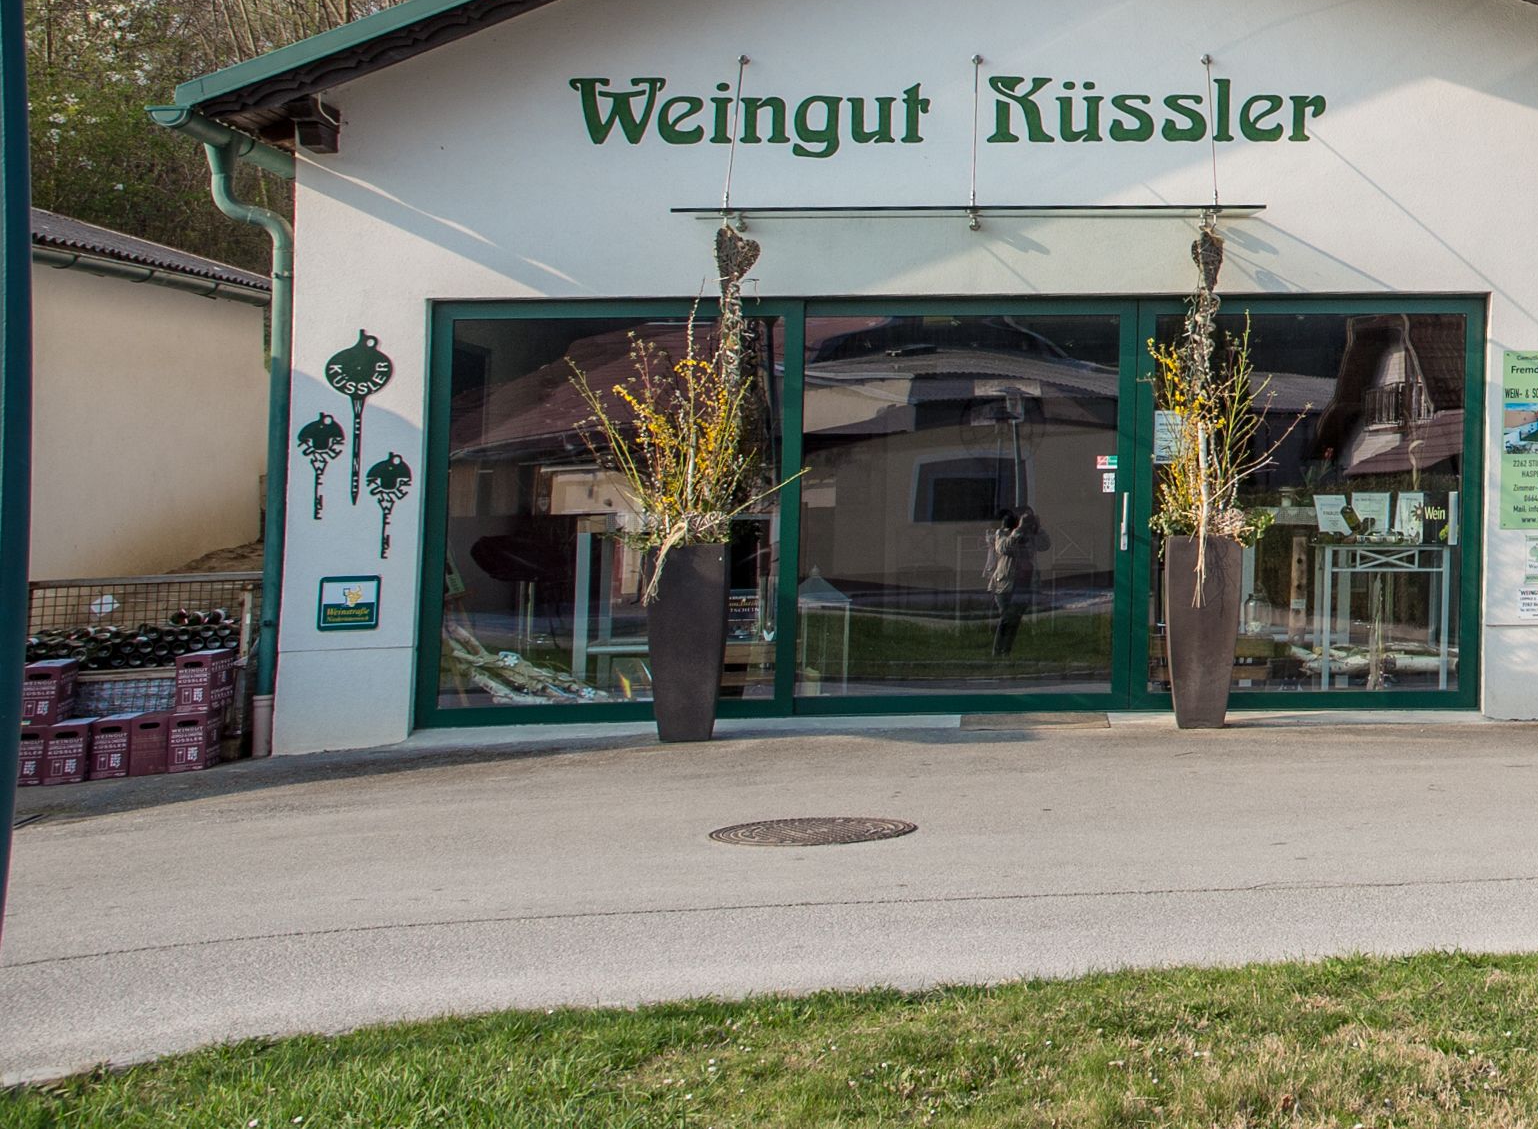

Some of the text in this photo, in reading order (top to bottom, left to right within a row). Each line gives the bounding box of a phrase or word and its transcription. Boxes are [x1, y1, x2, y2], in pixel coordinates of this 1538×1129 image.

[569, 75, 1327, 158] Weingut Küssler
[328, 361, 389, 395] KÜSSLER
[1504, 387, 1523, 399] WEIN-
[1424, 506, 1446, 520] Wein
